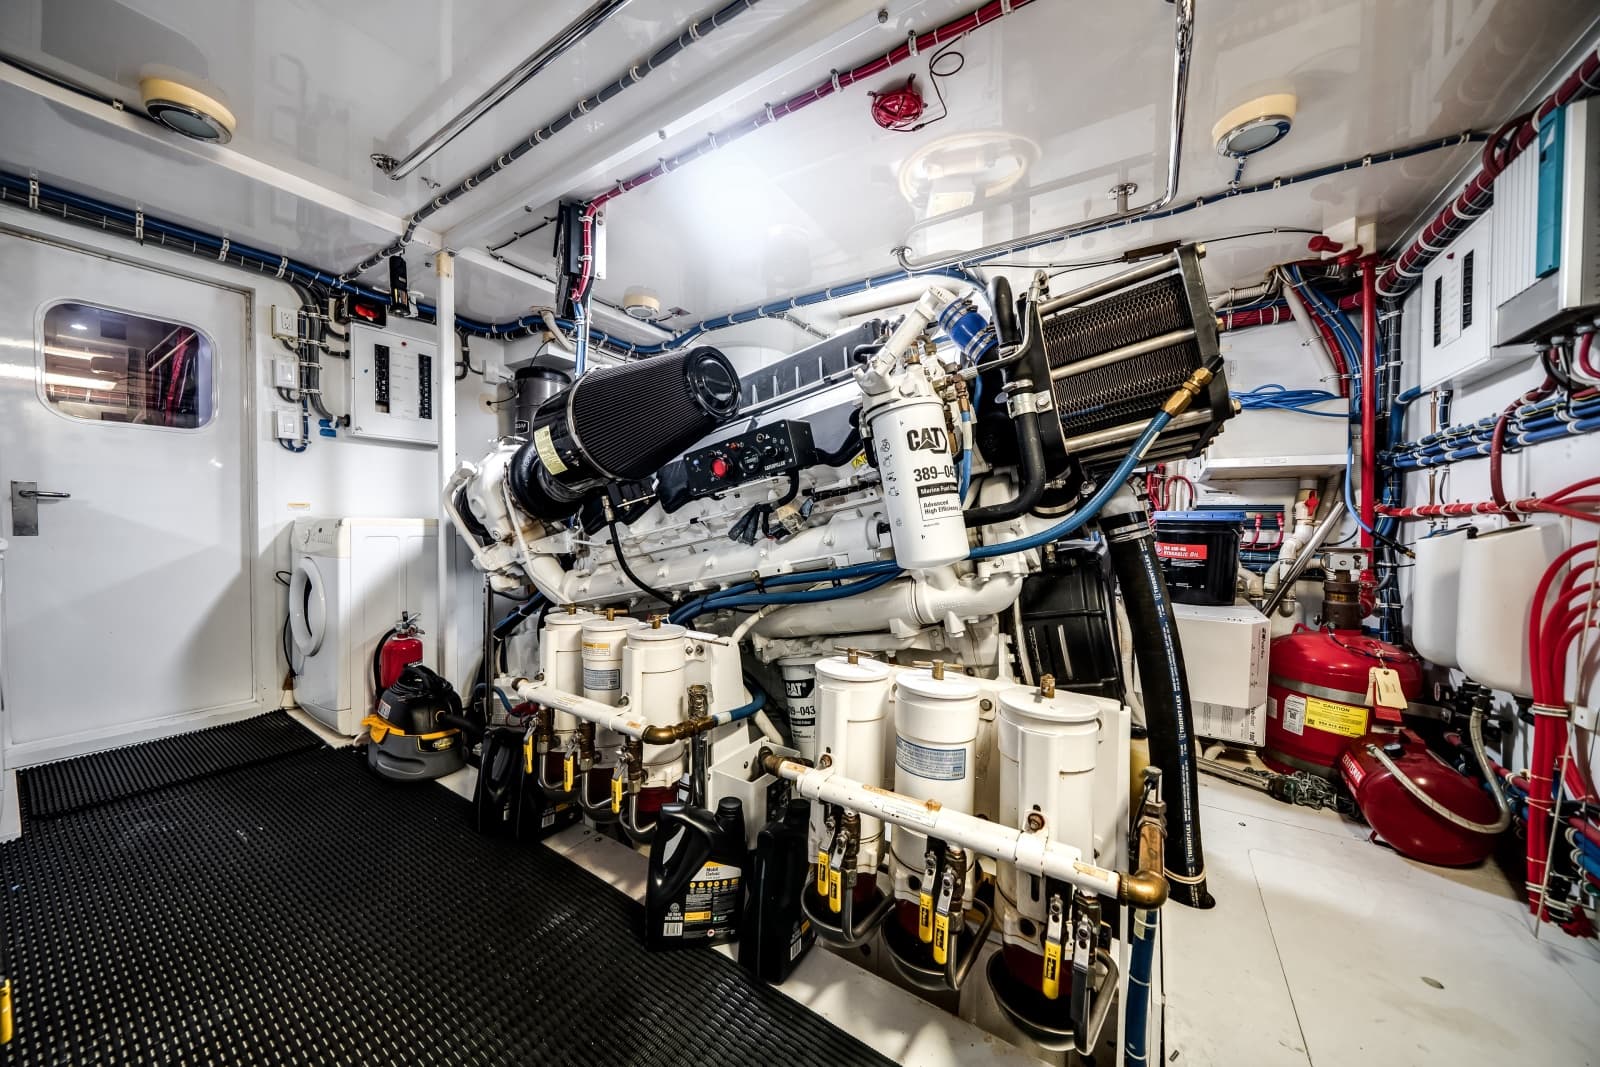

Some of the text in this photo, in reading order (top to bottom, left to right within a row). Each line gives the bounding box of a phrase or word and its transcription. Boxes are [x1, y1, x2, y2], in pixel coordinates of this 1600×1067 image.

[906, 427, 942, 452] CAT
[923, 499, 949, 509] Advanced
[924, 507, 938, 515] High
[786, 682, 802, 697] CAT
[1322, 703, 1351, 713] CAUTION
